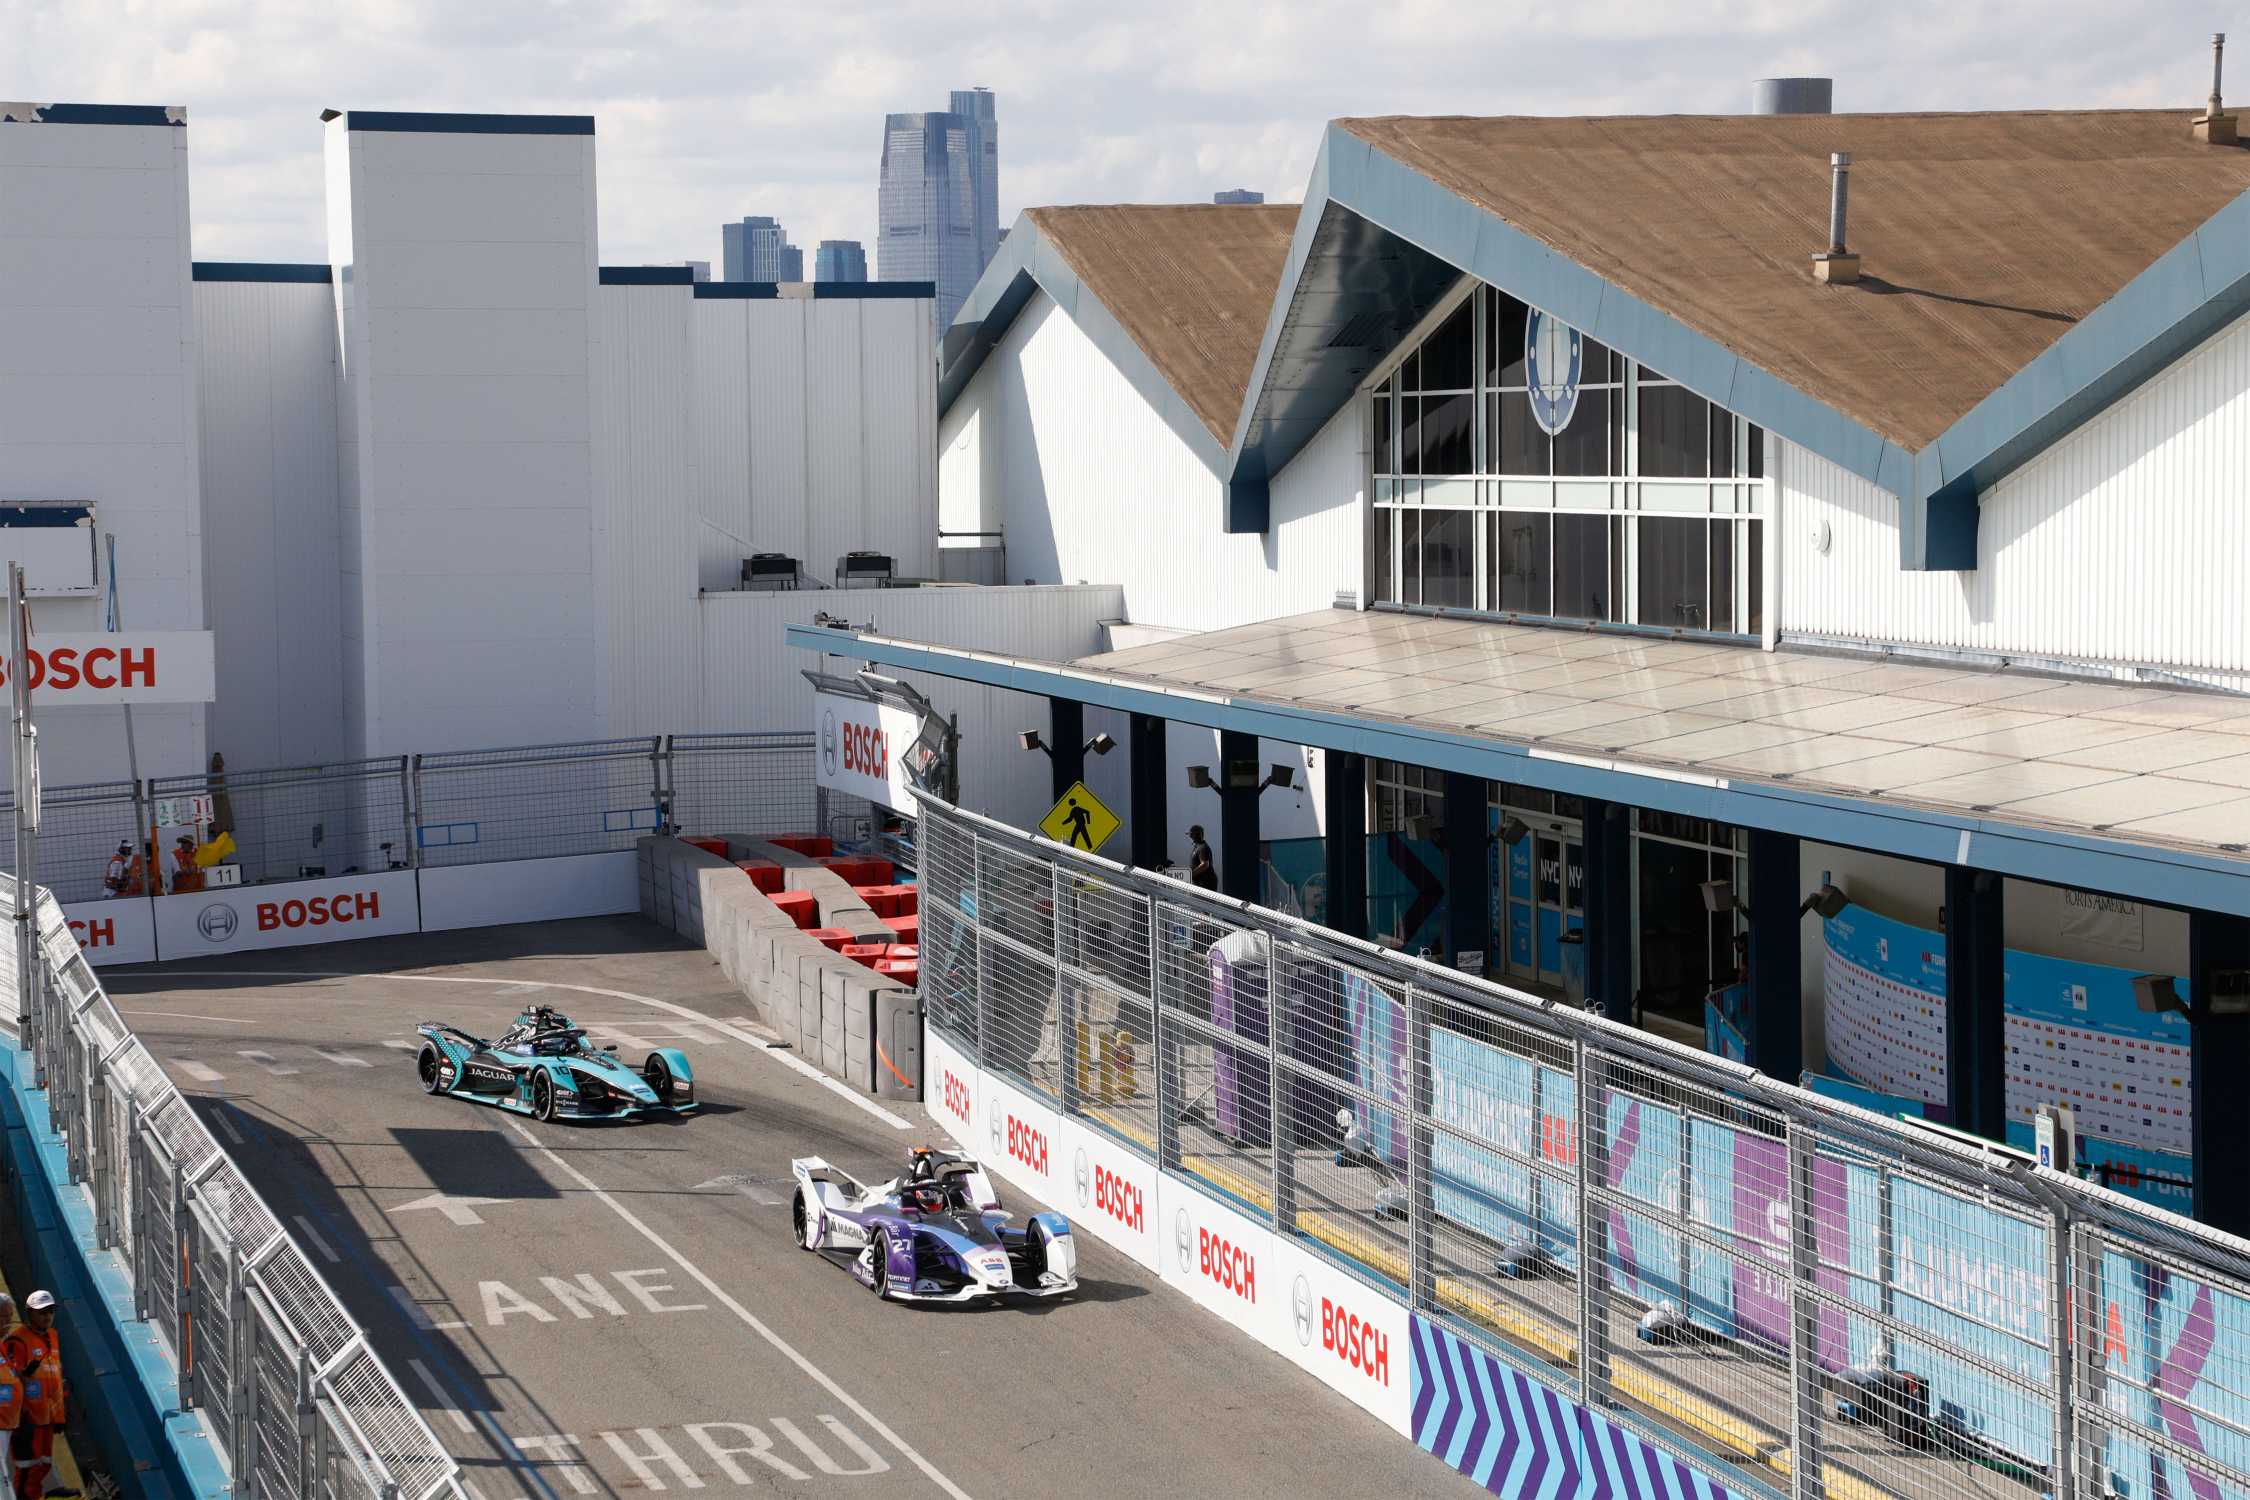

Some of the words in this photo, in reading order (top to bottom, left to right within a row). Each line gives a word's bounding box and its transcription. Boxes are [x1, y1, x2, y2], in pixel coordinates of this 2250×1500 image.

[0, 647, 155, 689] OSCH
[843, 722, 889, 780] BOSCH
[217, 869, 232, 883] 11
[1540, 858, 1560, 884] NYC
[256, 891, 380, 931] BOSCH
[467, 1068, 516, 1082] JAGUAR
[944, 1070, 970, 1126] BOSCH
[1007, 1115, 1048, 1177] BOSCH
[1095, 1164, 1143, 1234] BOSCH
[2145, 1167, 2192, 1198] FOR
[837, 1222, 863, 1241] MAGNA
[892, 1239, 912, 1254] 27
[1200, 1226, 1256, 1304] BOSCH
[387, 1268, 707, 1330] LANE
[1322, 1296, 1389, 1387] BOSCH
[514, 1415, 890, 1495] THRU
